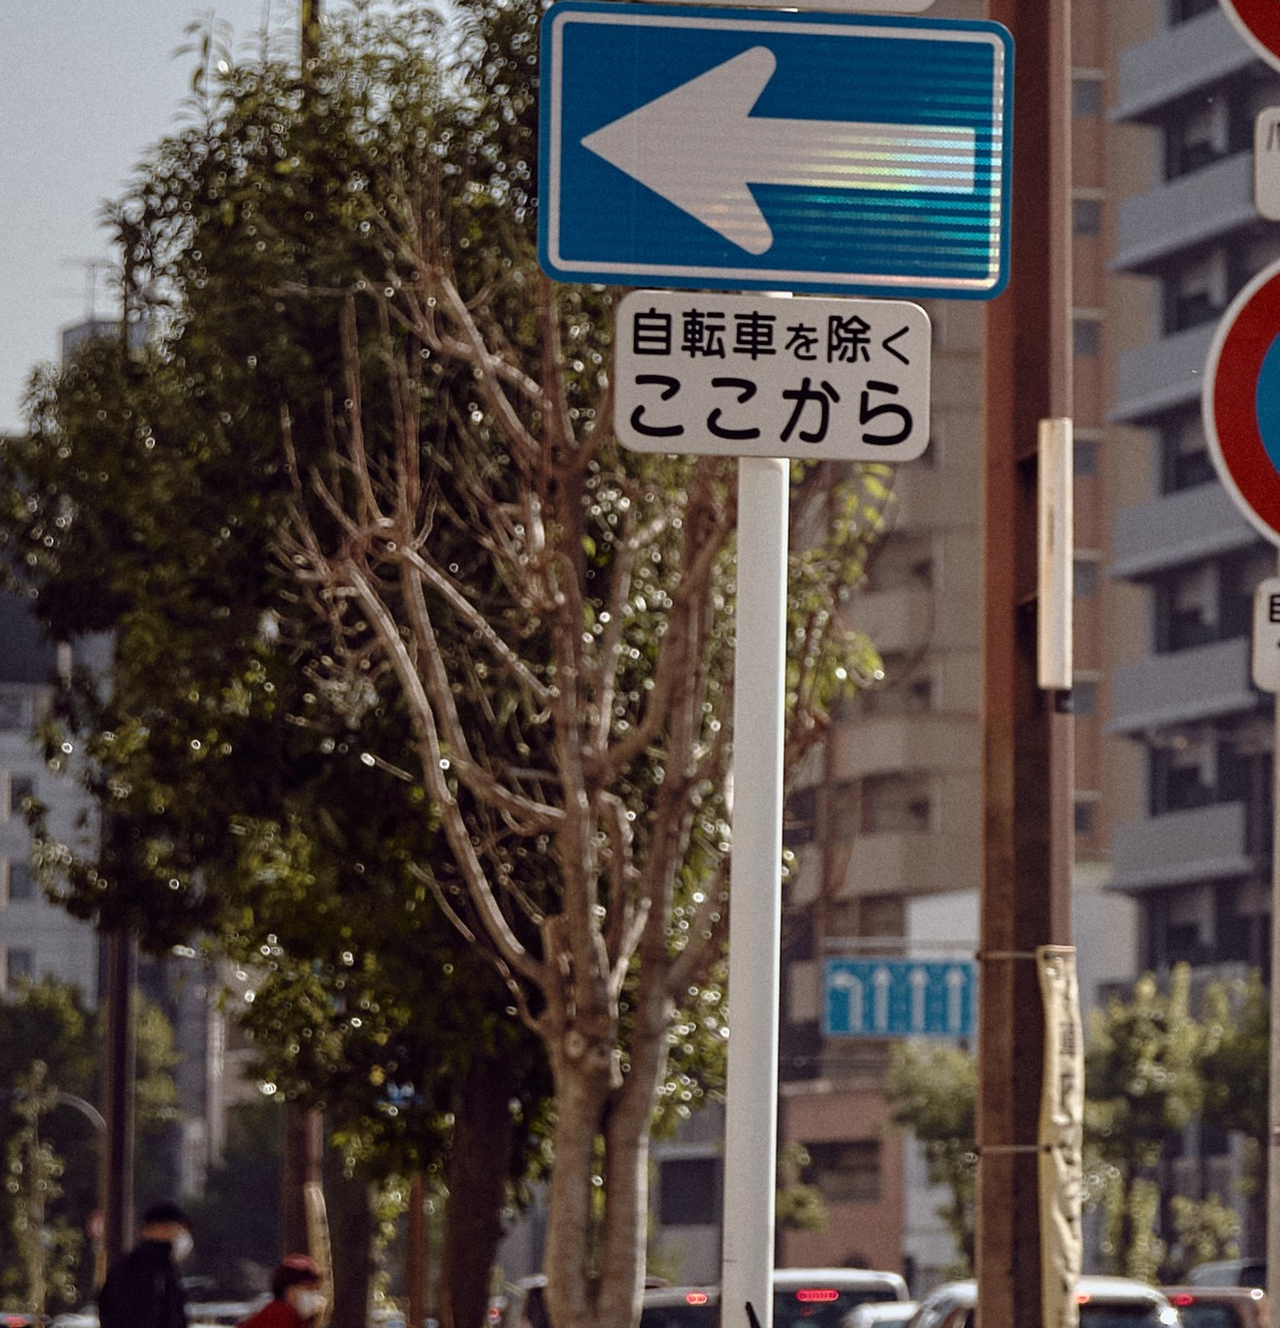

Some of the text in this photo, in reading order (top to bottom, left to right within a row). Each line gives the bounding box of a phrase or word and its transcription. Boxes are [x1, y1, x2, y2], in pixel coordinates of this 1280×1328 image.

[632, 307, 910, 366] 自転車を除く
[630, 375, 913, 446] ここから
